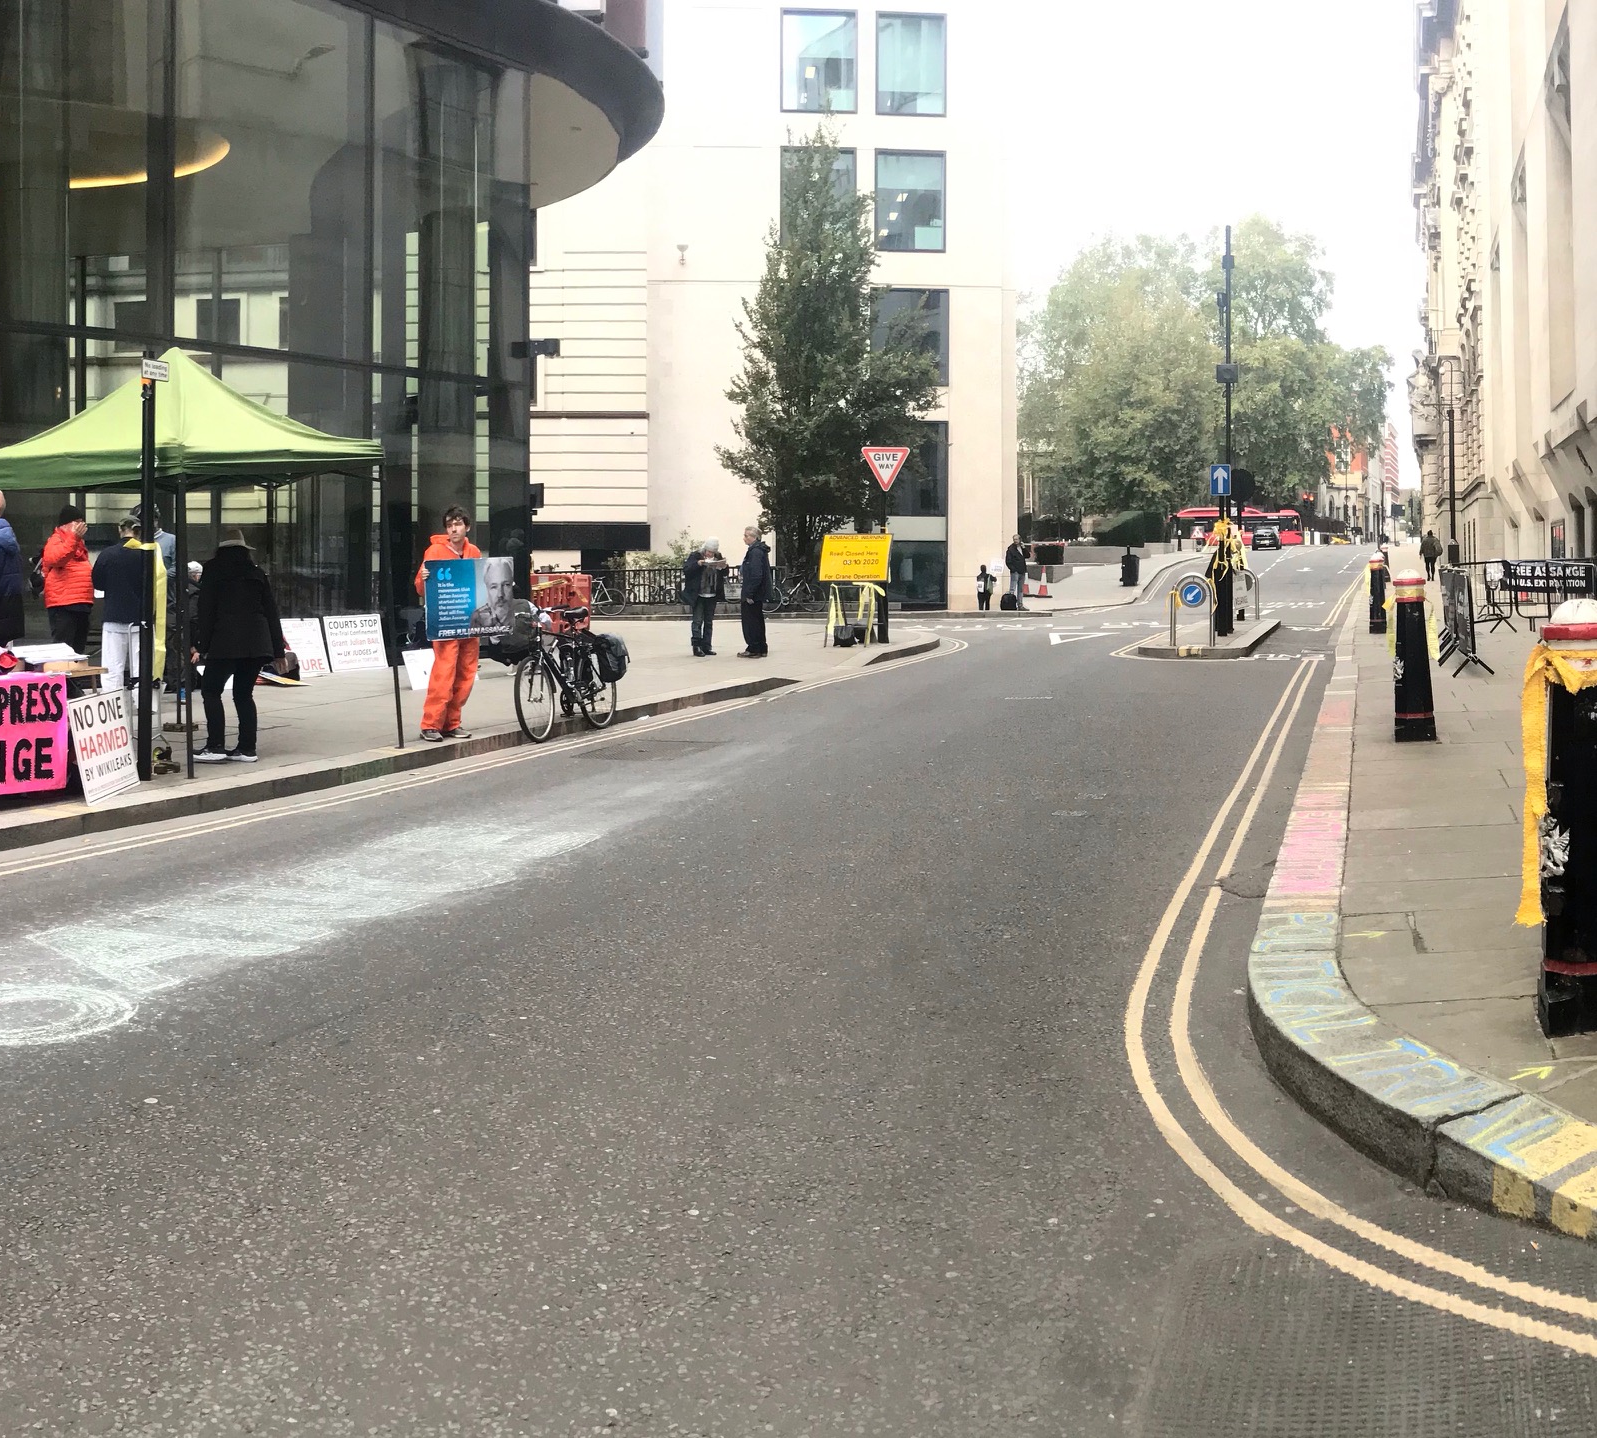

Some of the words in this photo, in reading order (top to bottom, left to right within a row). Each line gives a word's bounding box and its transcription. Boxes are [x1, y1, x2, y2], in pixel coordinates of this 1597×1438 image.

[873, 453, 898, 461] GIVE
[328, 620, 358, 630] COURTS
[360, 619, 378, 628] STOP
[438, 628, 456, 637] FREE
[456, 627, 481, 636] JULIAN
[481, 625, 511, 634] ASSANGE
[73, 704, 94, 732] NO
[97, 696, 123, 724] ONE
[79, 725, 128, 762] HARMED
[85, 767, 95, 782] BY
[96, 753, 133, 777] WIKILEAKS
